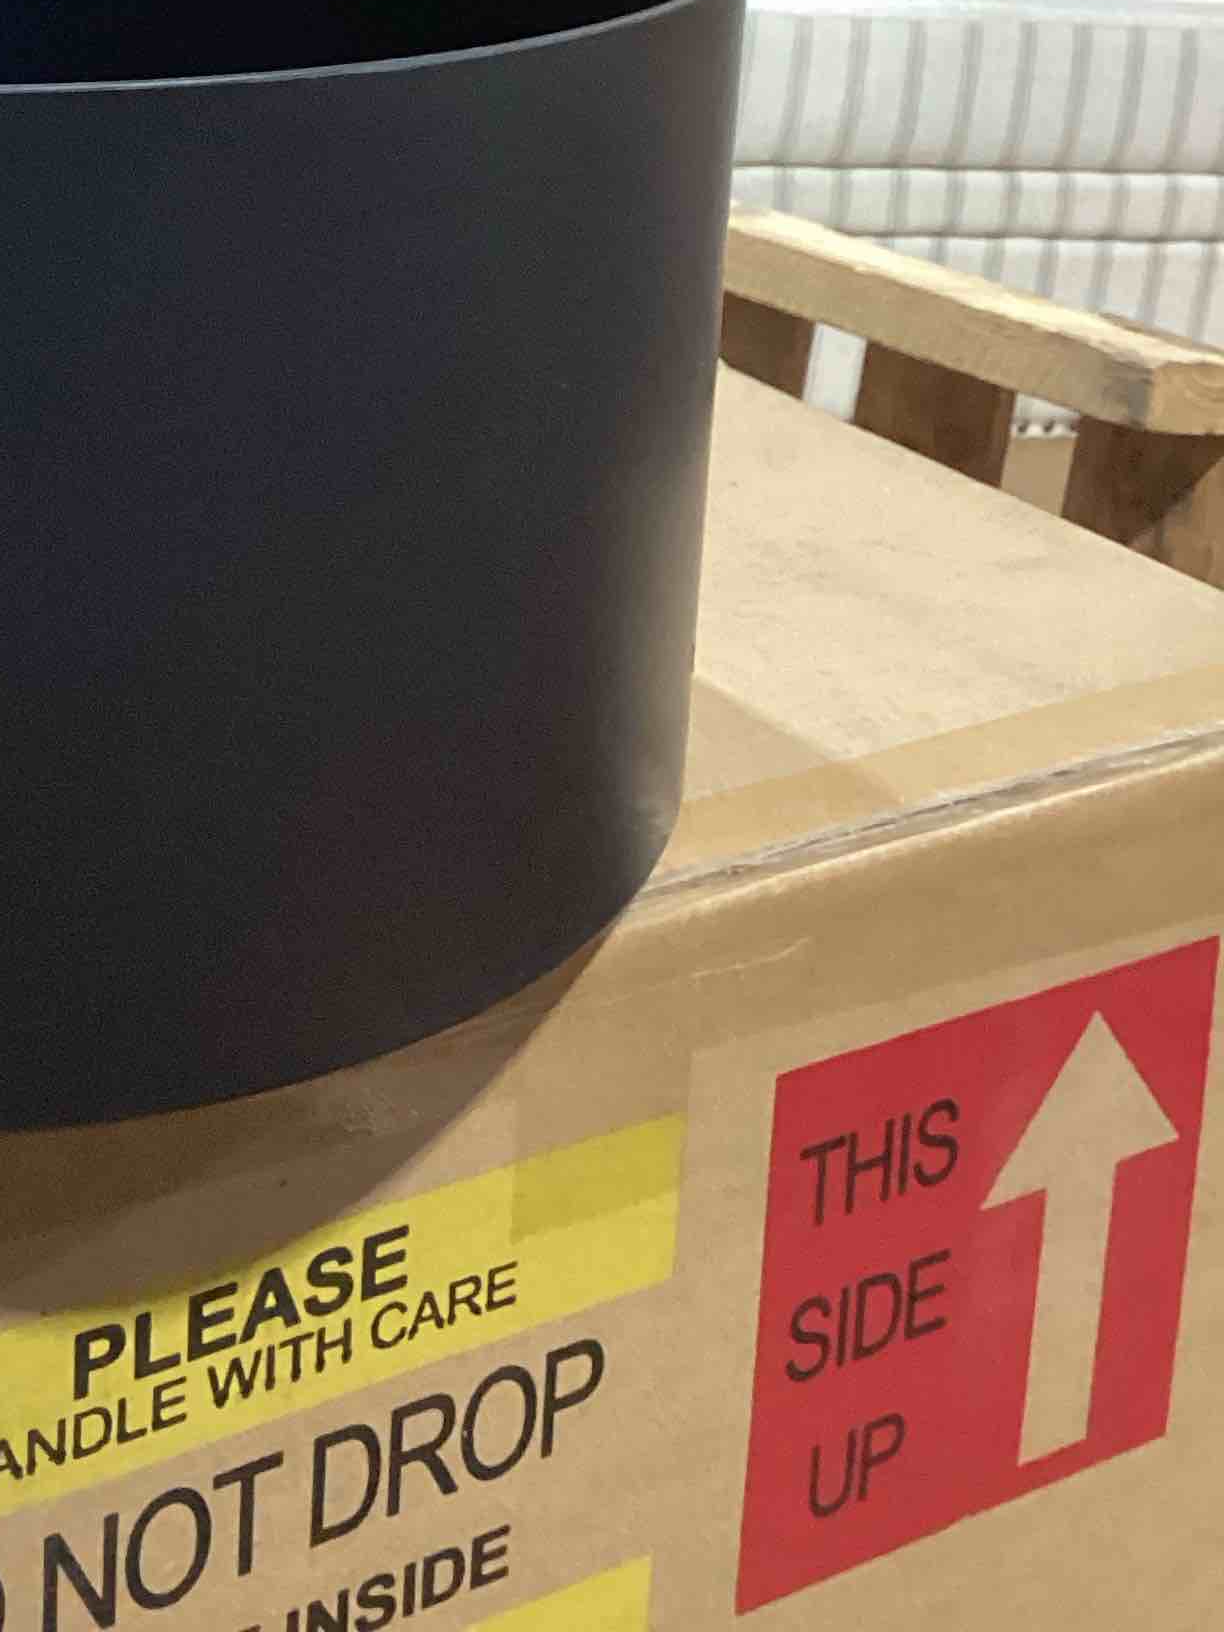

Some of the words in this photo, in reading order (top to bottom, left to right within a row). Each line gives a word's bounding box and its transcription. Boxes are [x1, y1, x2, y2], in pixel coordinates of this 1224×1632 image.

[799, 1097, 961, 1227] THIS
[72, 1223, 411, 1401] PLEASE
[208, 1323, 354, 1408] WITH
[369, 1260, 520, 1351] CARE
[784, 1248, 953, 1384] SIDE
[42, 1452, 285, 1632] NOT
[309, 1337, 606, 1549] DROP
[807, 1411, 907, 1520] UP
